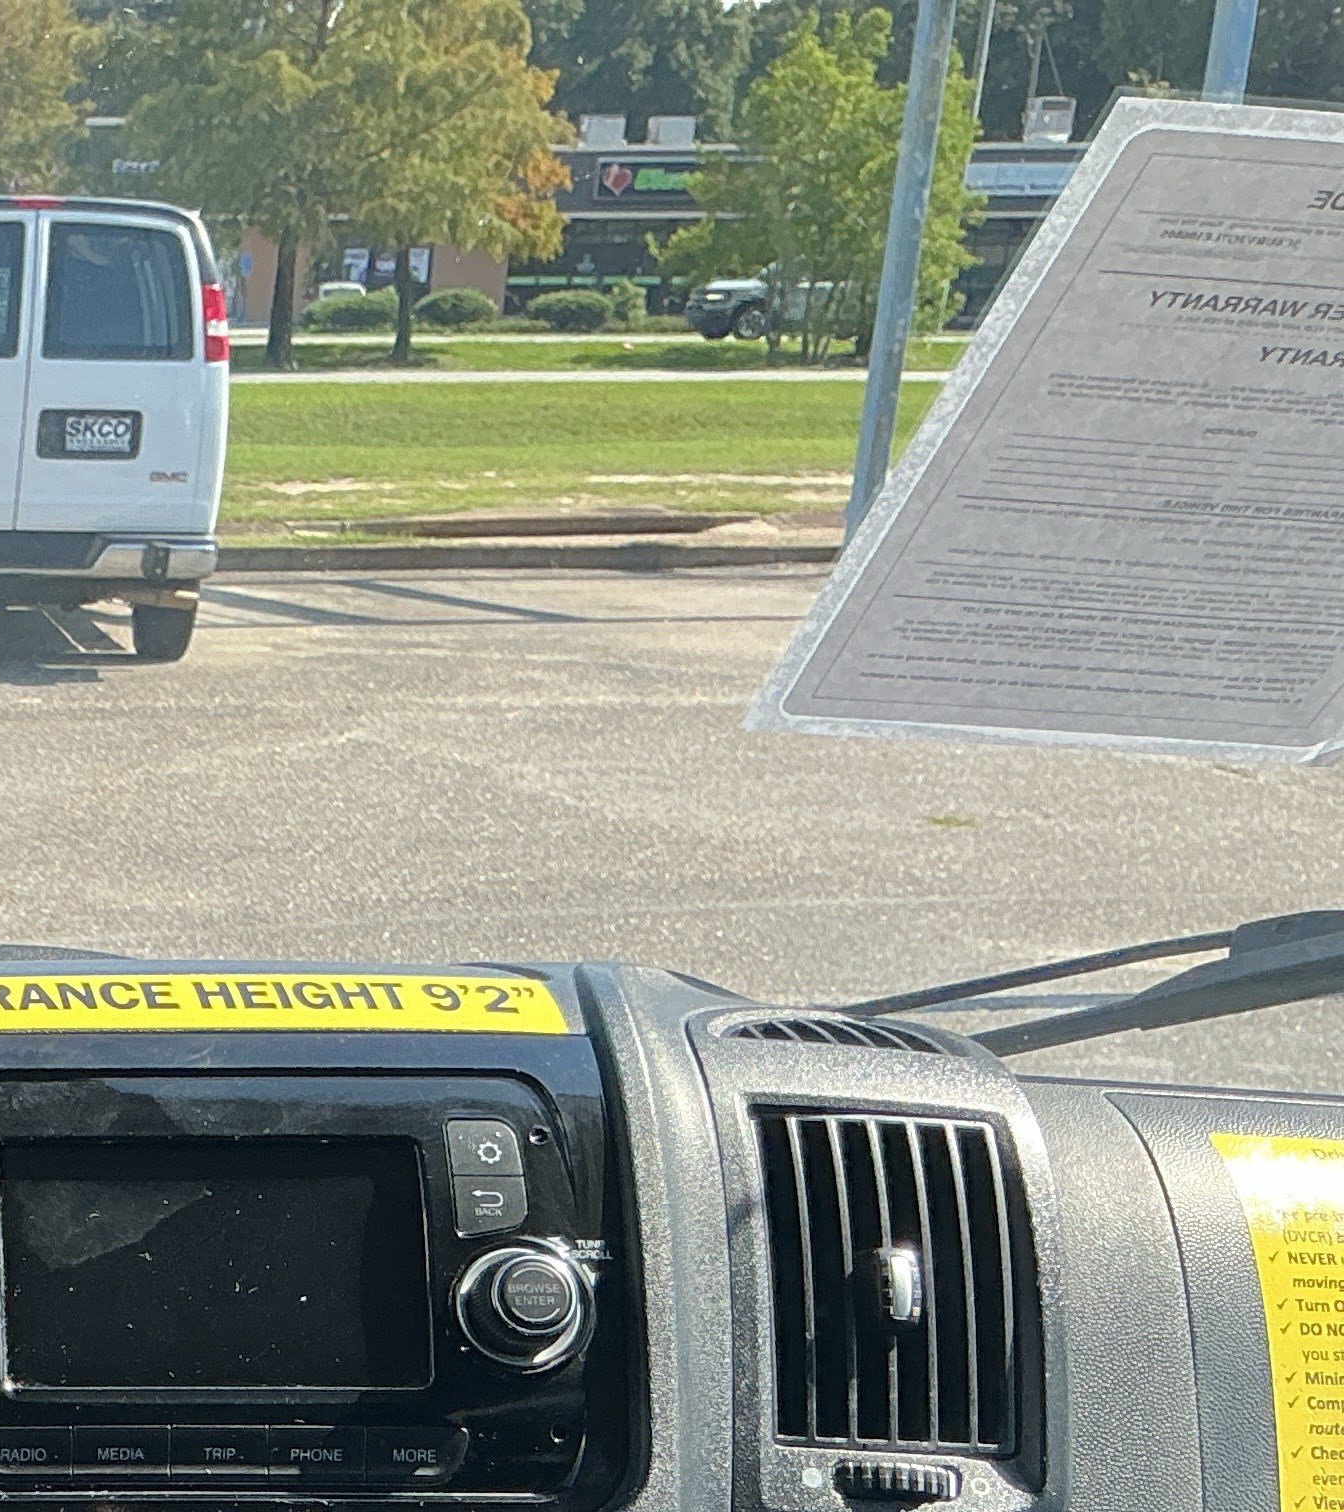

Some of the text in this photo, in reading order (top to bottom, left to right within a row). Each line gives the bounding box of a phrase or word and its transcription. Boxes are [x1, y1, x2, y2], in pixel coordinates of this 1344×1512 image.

[67, 420, 131, 439] SKCO
[191, 982, 405, 1012] HEIGHT
[474, 1207, 503, 1217] BACK
[572, 1250, 614, 1260] SCROLL
[1287, 1252, 1338, 1266] NEVER
[507, 1283, 561, 1294] BROWSE
[515, 1296, 556, 1306] ENTER
[1295, 1299, 1330, 1313] Turn
[1299, 1322, 1323, 1336] DO
[1302, 1350, 1330, 1364] you
[0, 1447, 47, 1462] RADIO
[97, 1447, 145, 1461] MEDIA
[203, 1447, 237, 1461] TRIP
[289, 1448, 344, 1462] PHONE
[392, 1449, 437, 1463] MORE
